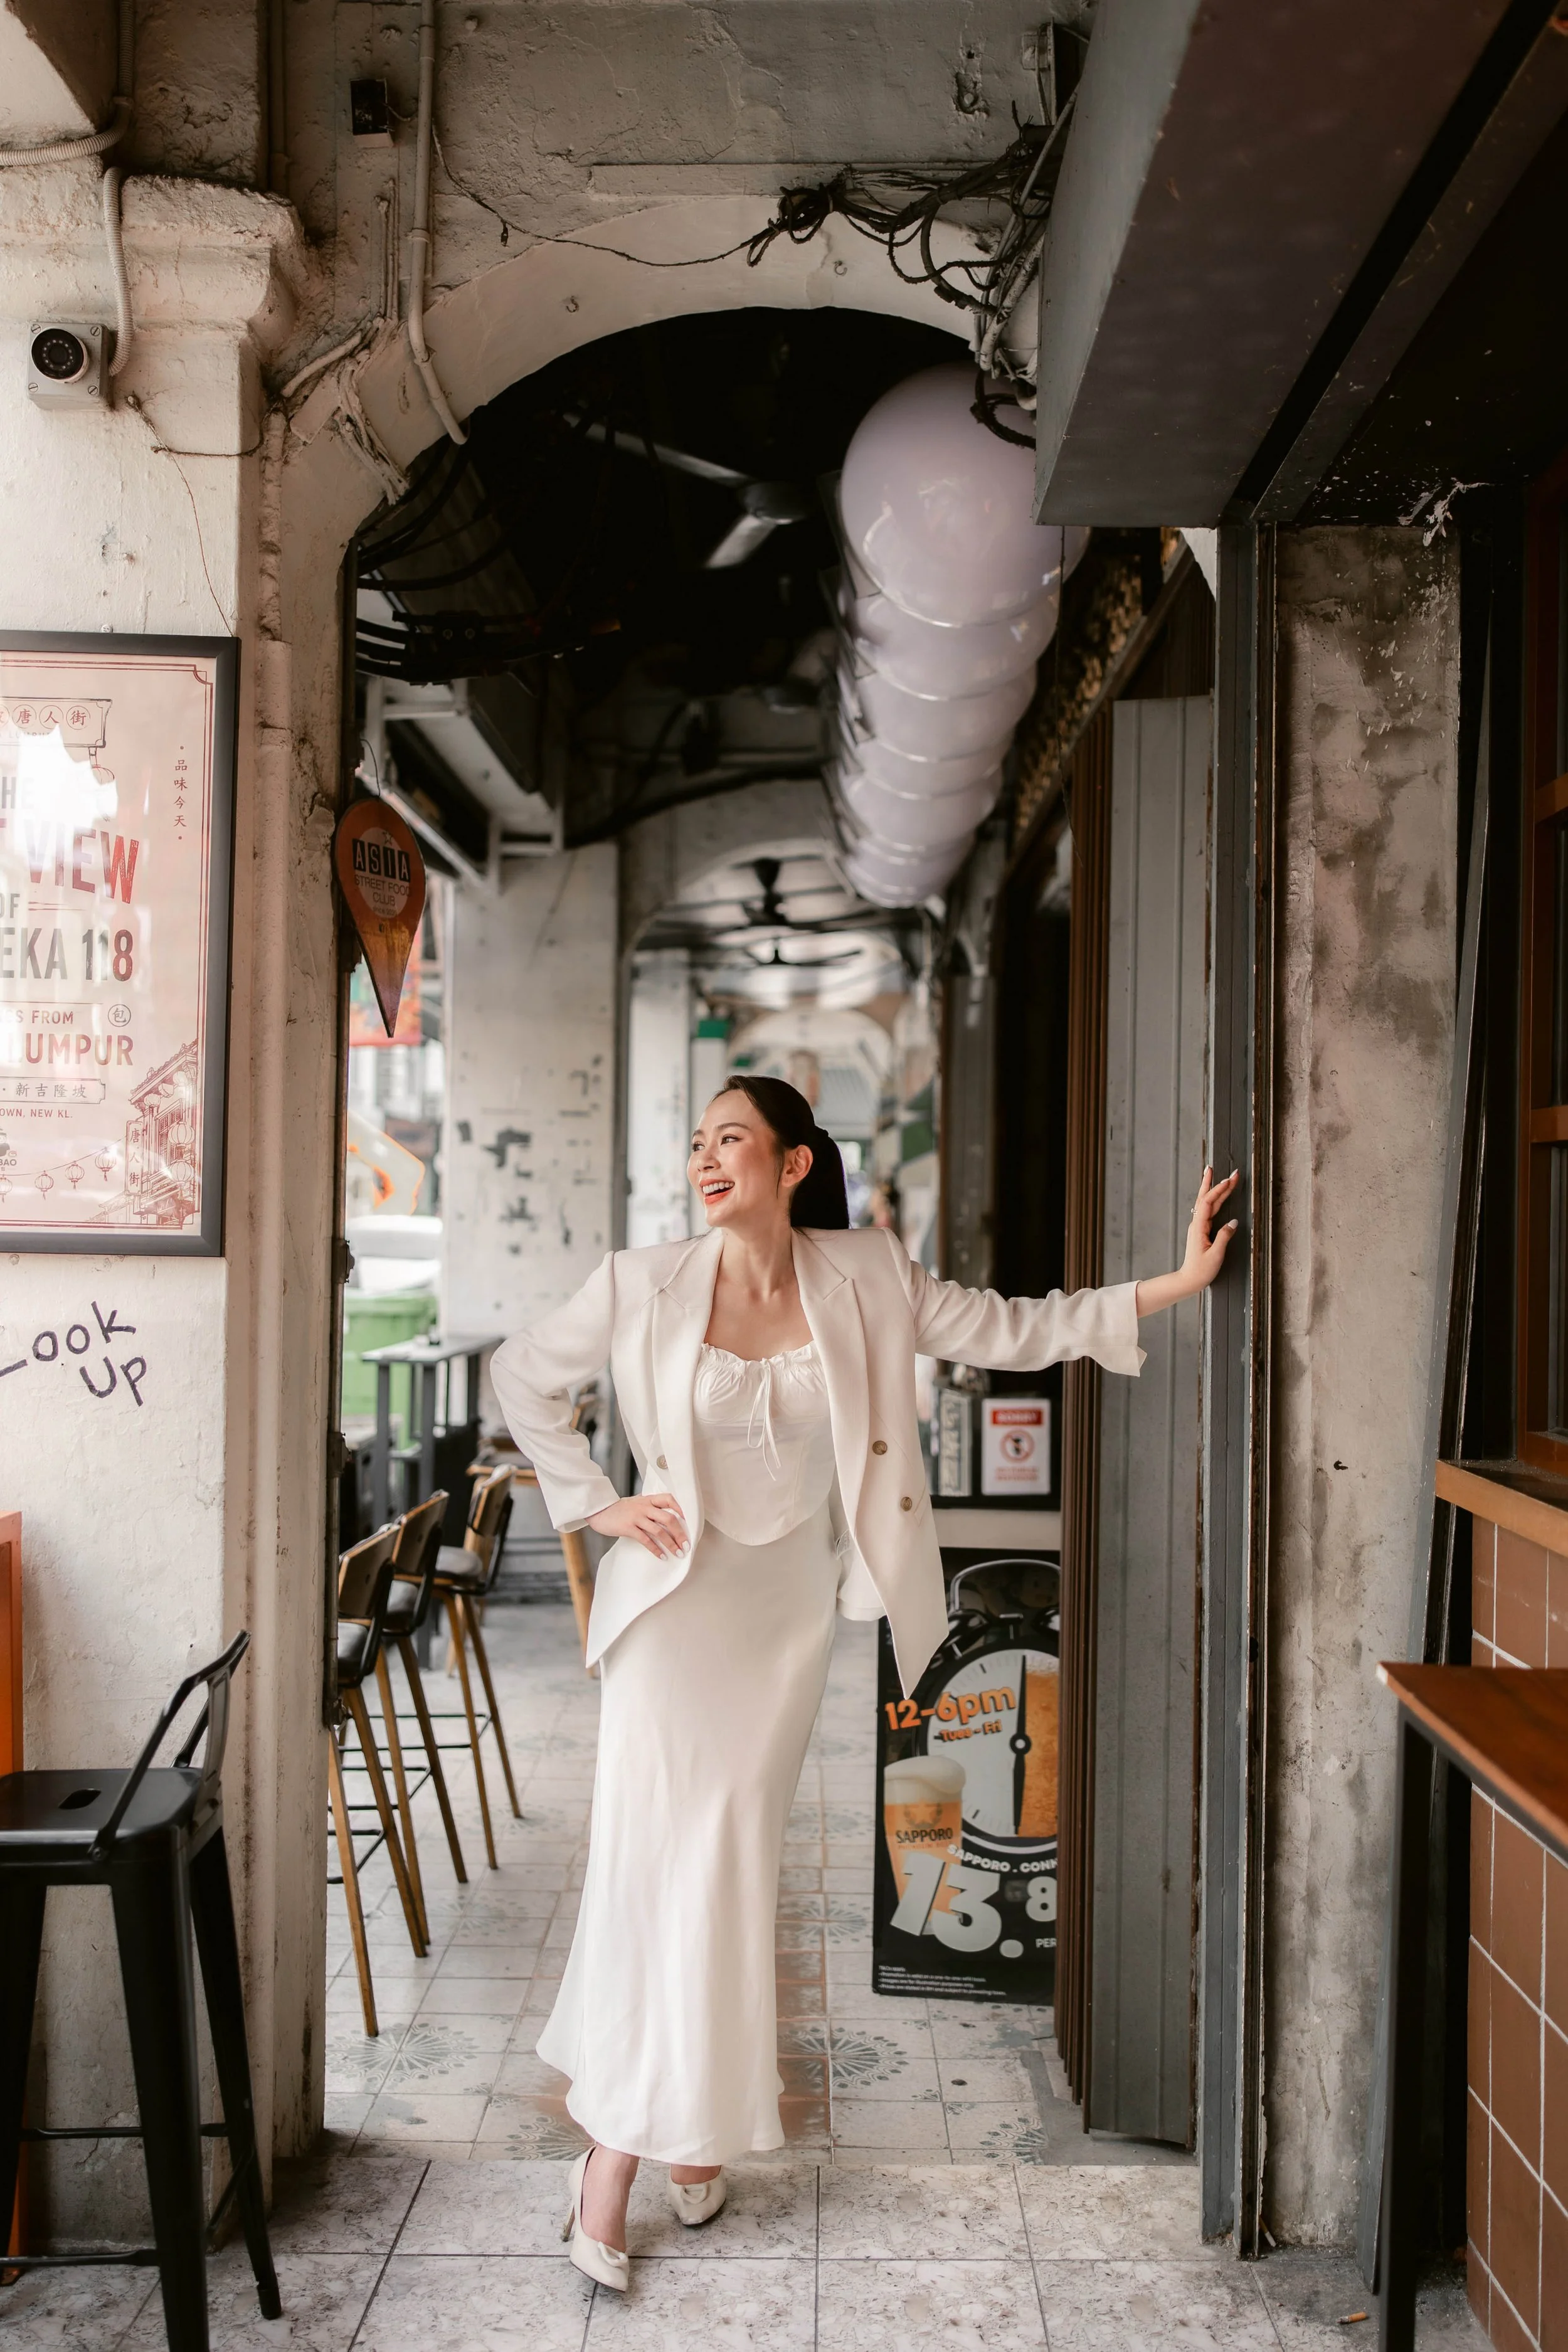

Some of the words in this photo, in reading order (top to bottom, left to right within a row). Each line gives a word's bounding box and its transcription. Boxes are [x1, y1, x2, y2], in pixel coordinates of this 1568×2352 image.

[173, 759, 188, 828] 品味今天
[23, 818, 140, 904] VIEW
[355, 841, 410, 880] ASIA
[354, 874, 386, 891] STREET
[388, 882, 412, 897] FOOD
[373, 891, 396, 907] CLUB
[82, 928, 133, 982] 118
[32, 1010, 73, 1024] FROM
[112, 1007, 127, 1024] 包
[16, 1083, 87, 1098] 新吉隆坡
[31, 1109, 53, 1118] NEW
[58, 1110, 73, 1118] KL.
[129, 1128, 140, 1187] 唐人街
[80, 1355, 147, 1407] UP
[885, 1687, 1017, 1730] 12-6pm
[939, 1728, 973, 1742] Tues
[983, 1719, 1002, 1735] Fri
[896, 1827, 953, 1844] SAPPORO
[946, 1843, 1011, 1873] SAPPORO
[1036, 1937, 1057, 1949] PER
